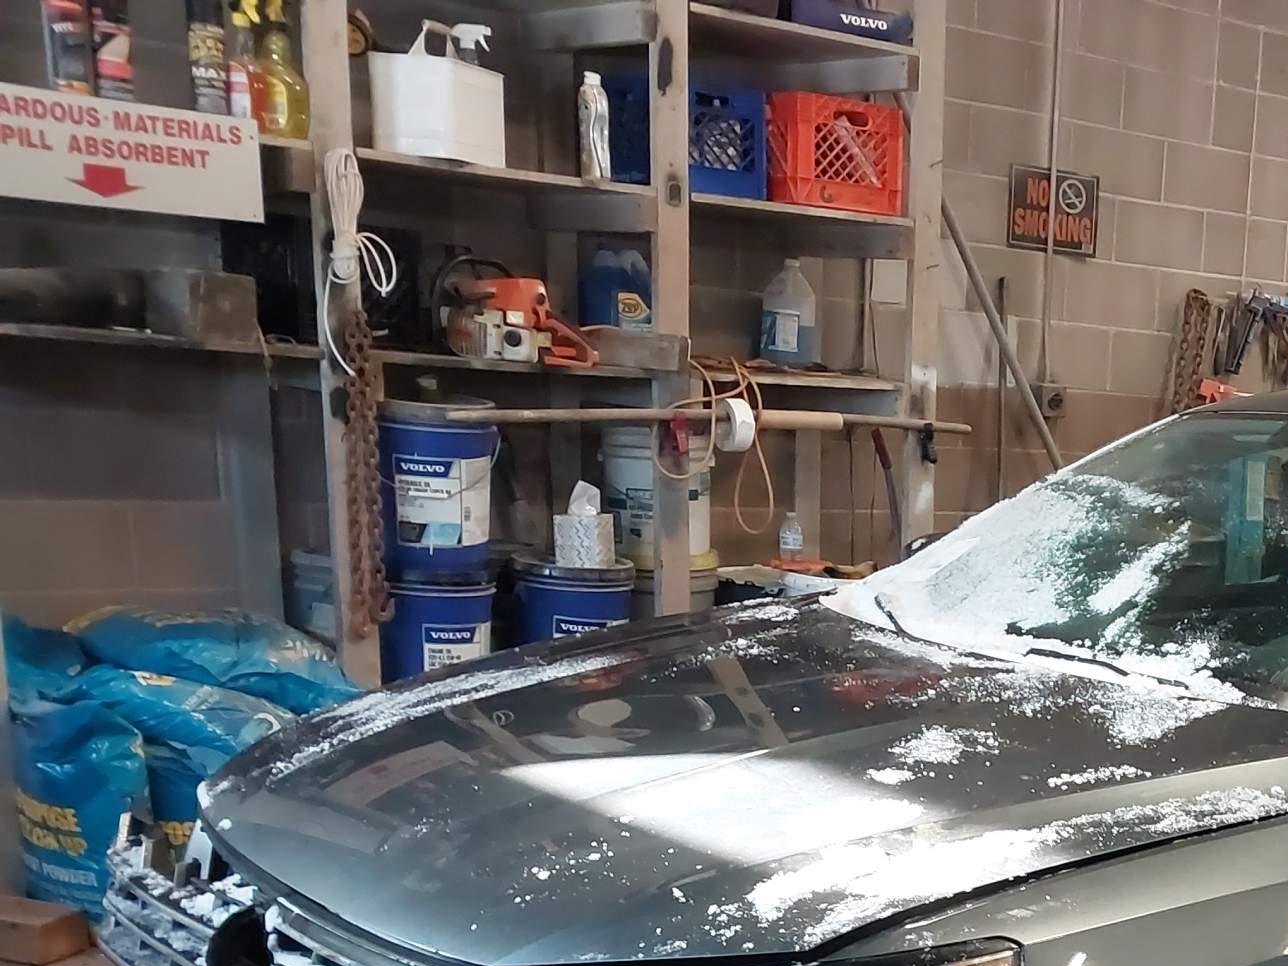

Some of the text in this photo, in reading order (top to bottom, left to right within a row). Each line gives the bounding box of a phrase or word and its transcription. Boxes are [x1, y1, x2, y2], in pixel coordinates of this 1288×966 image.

[840, 13, 888, 31] VOLVO
[0, 93, 243, 146] ARDOUS MATERIALS
[0, 124, 210, 169] PILL ABSORBENT
[1027, 177, 1050, 207] NO
[400, 462, 446, 473] VOLVO
[430, 631, 471, 640] VOLVO
